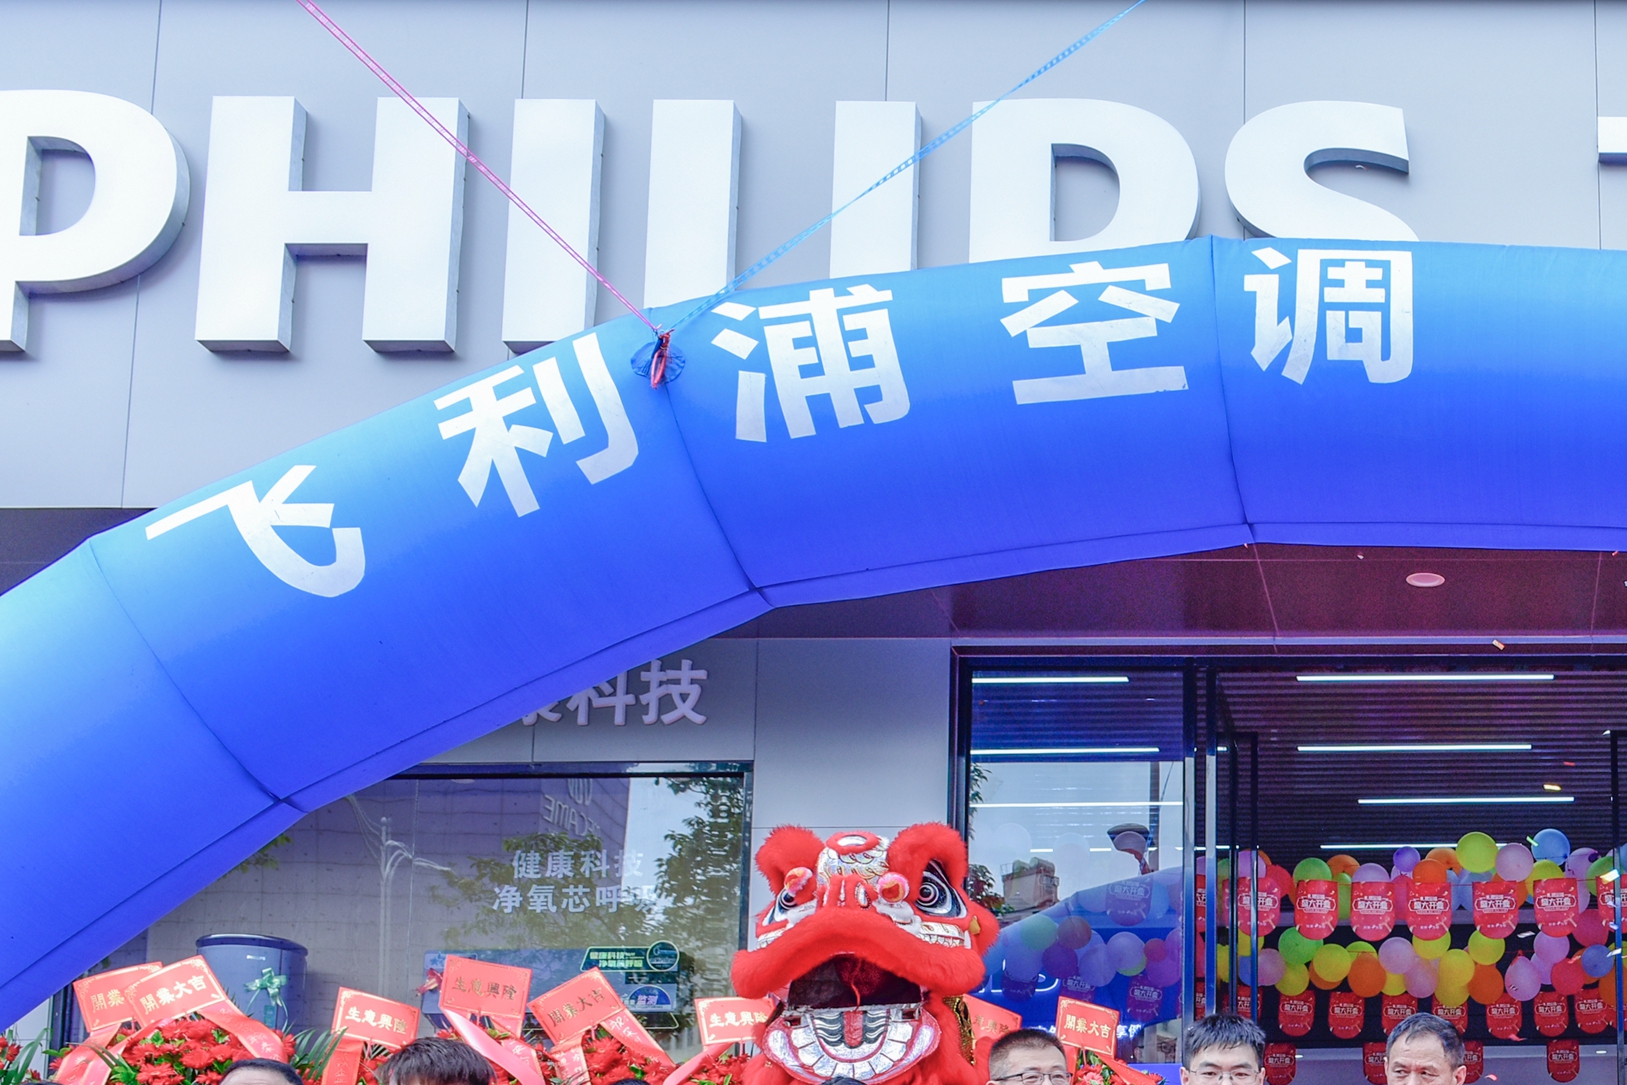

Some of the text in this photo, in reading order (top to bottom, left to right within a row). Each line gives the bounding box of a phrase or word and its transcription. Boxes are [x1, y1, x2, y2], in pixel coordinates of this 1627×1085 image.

[145, 246, 1414, 599] 飞利浦空调
[520, 659, 708, 726] 科技
[512, 849, 644, 879] 健康科技
[139, 974, 208, 1014] 開業大吉
[451, 975, 518, 1003] 生意興隆
[344, 1005, 409, 1036] 生意興隆
[547, 987, 606, 1028] 開業大吉
[973, 1014, 1011, 1034] 意興隆
[1063, 1013, 1112, 1039] 開業大吉
